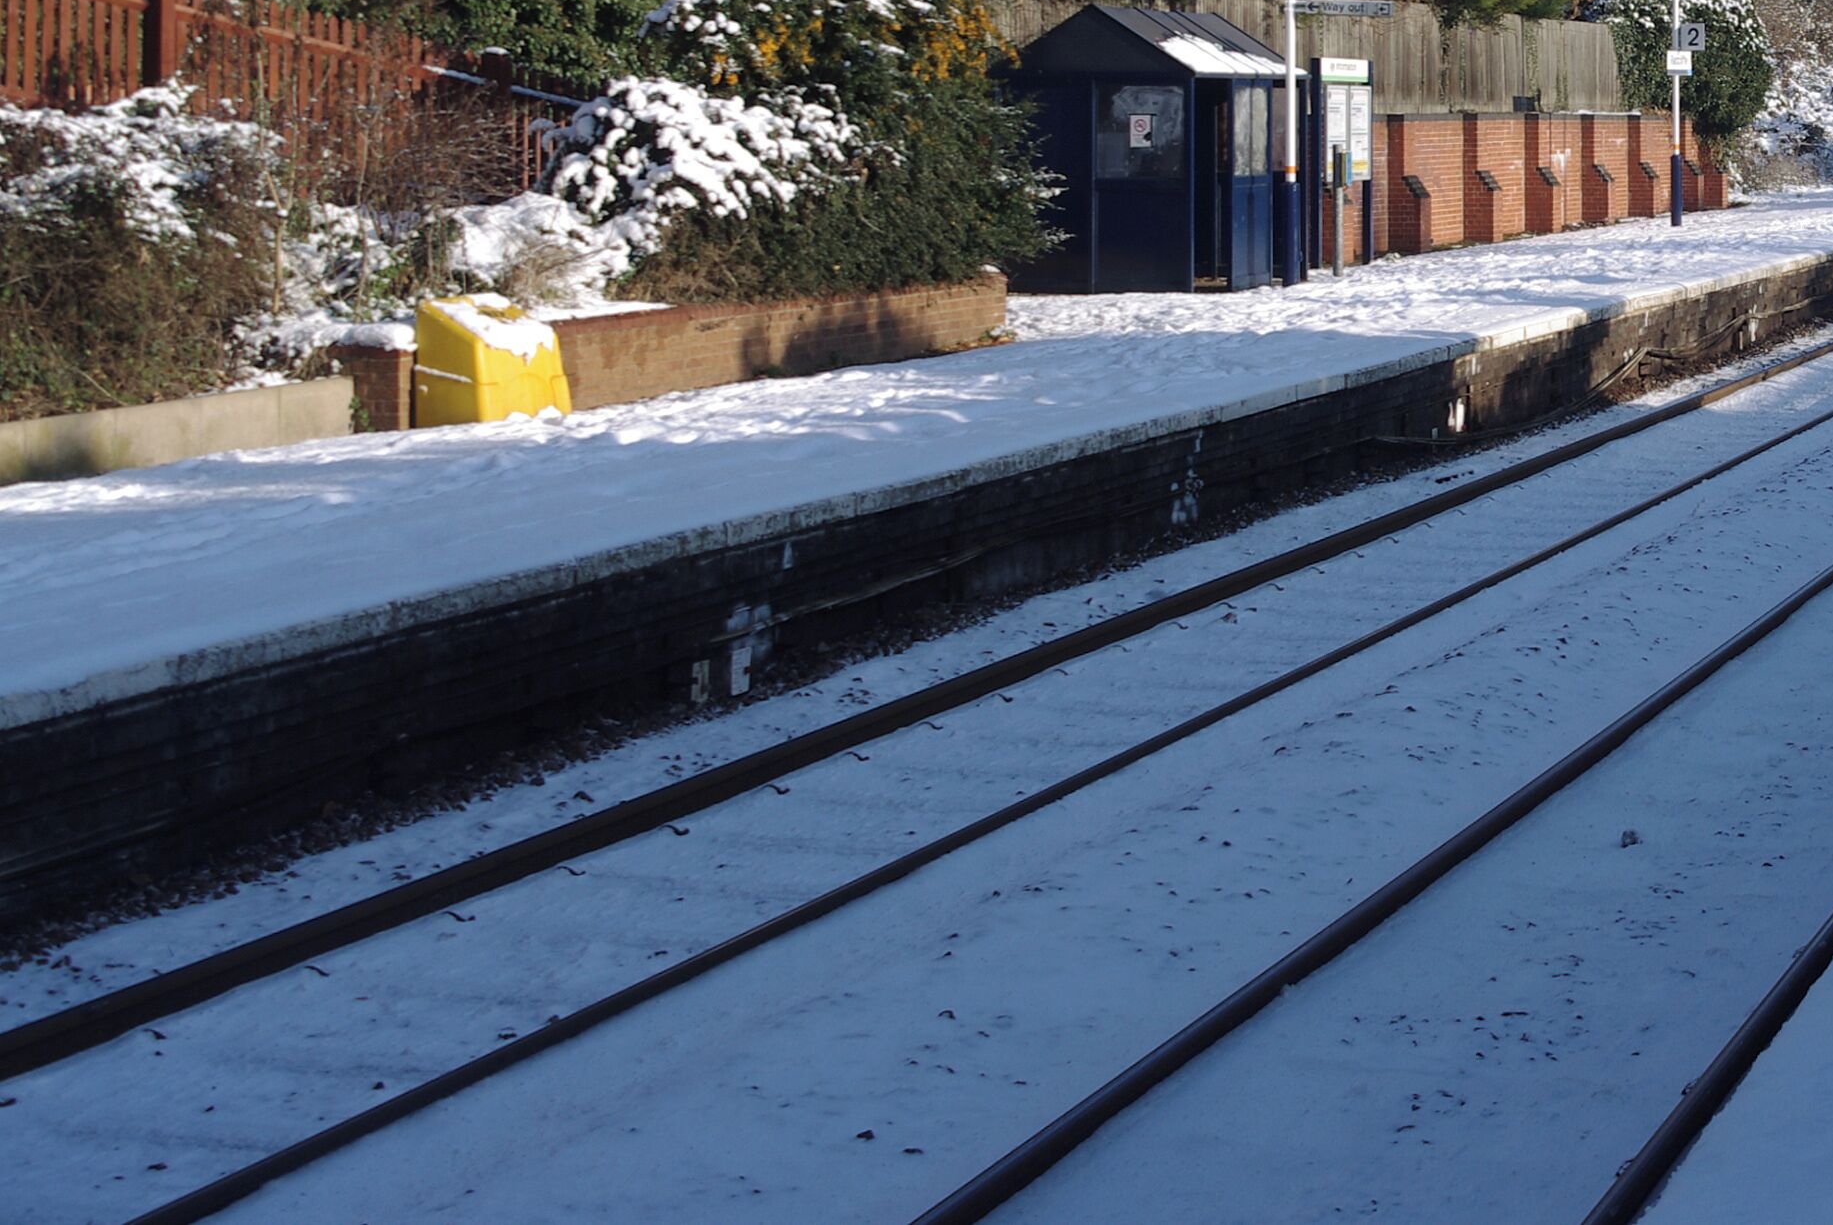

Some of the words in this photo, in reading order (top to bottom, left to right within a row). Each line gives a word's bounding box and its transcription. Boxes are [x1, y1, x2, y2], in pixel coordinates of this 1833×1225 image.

[1321, 2, 1344, 14] Way
[1348, 3, 1365, 13] out
[1687, 28, 1699, 46] 2
